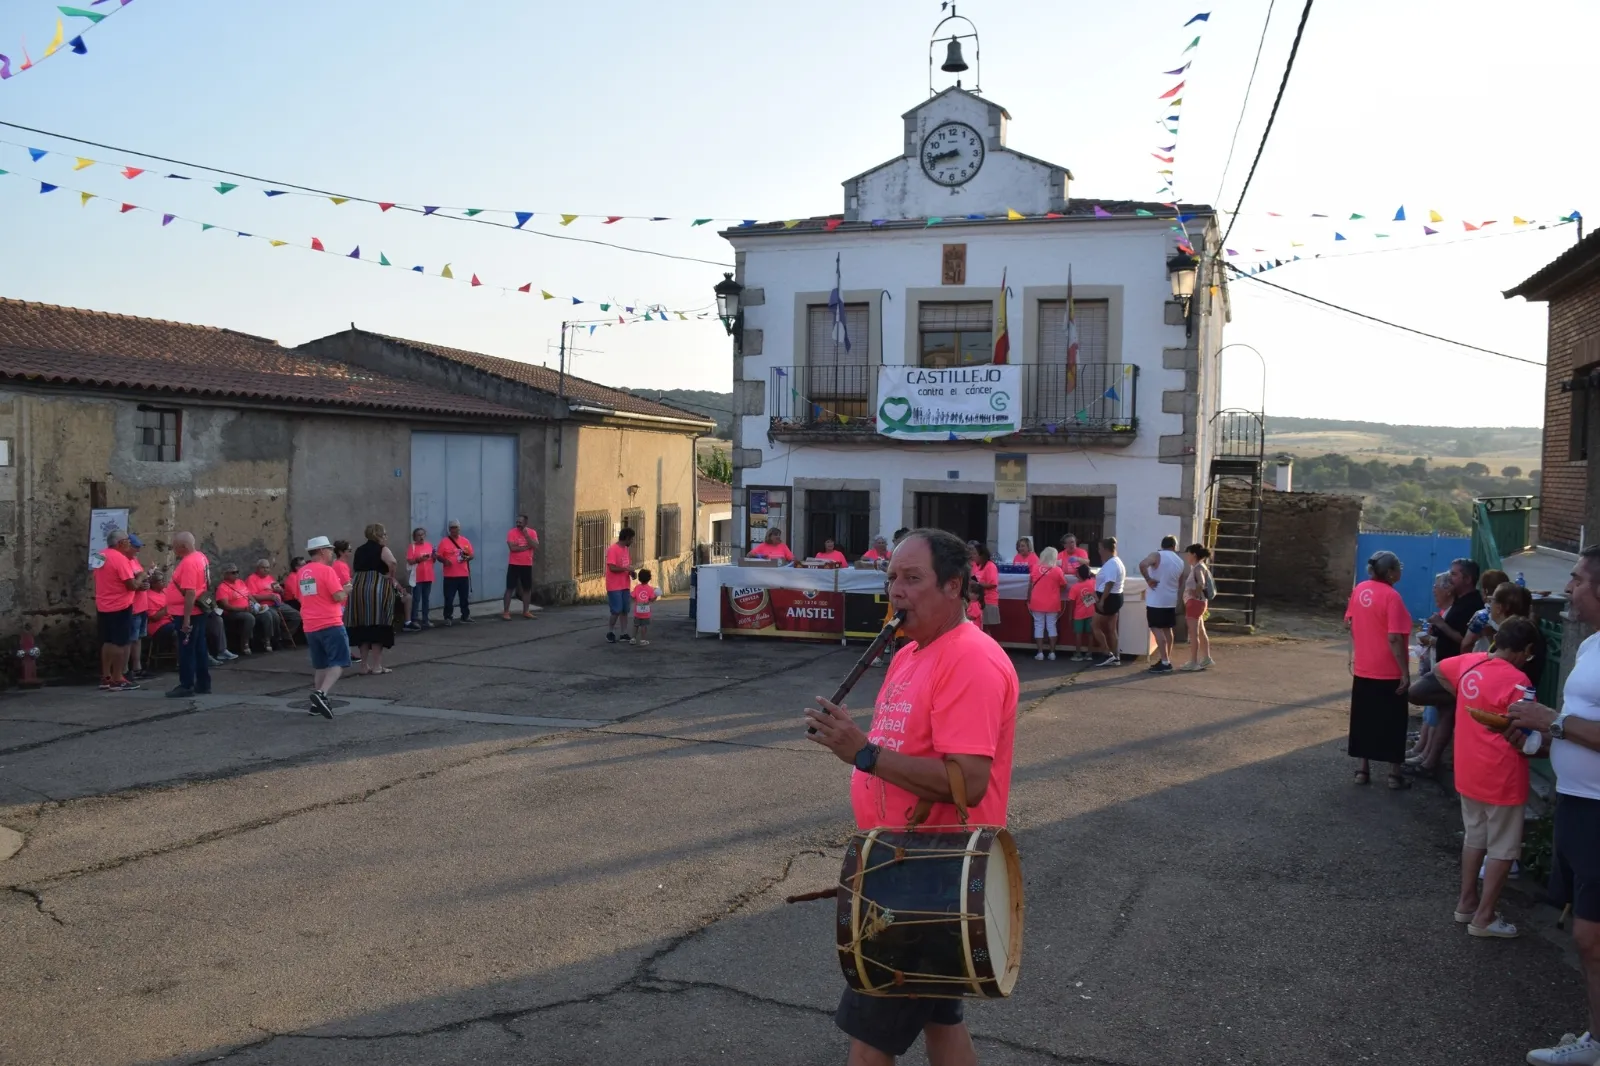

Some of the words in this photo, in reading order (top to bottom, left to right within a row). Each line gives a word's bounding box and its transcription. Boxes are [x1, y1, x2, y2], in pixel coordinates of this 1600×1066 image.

[948, 128, 957, 136] 12
[961, 170, 966, 178] 5
[906, 369, 1001, 384] CASTILLEJO
[918, 388, 944, 396] contra
[950, 388, 958, 396] el
[966, 384, 992, 394] cáncer
[786, 607, 834, 619] AMSTEL
